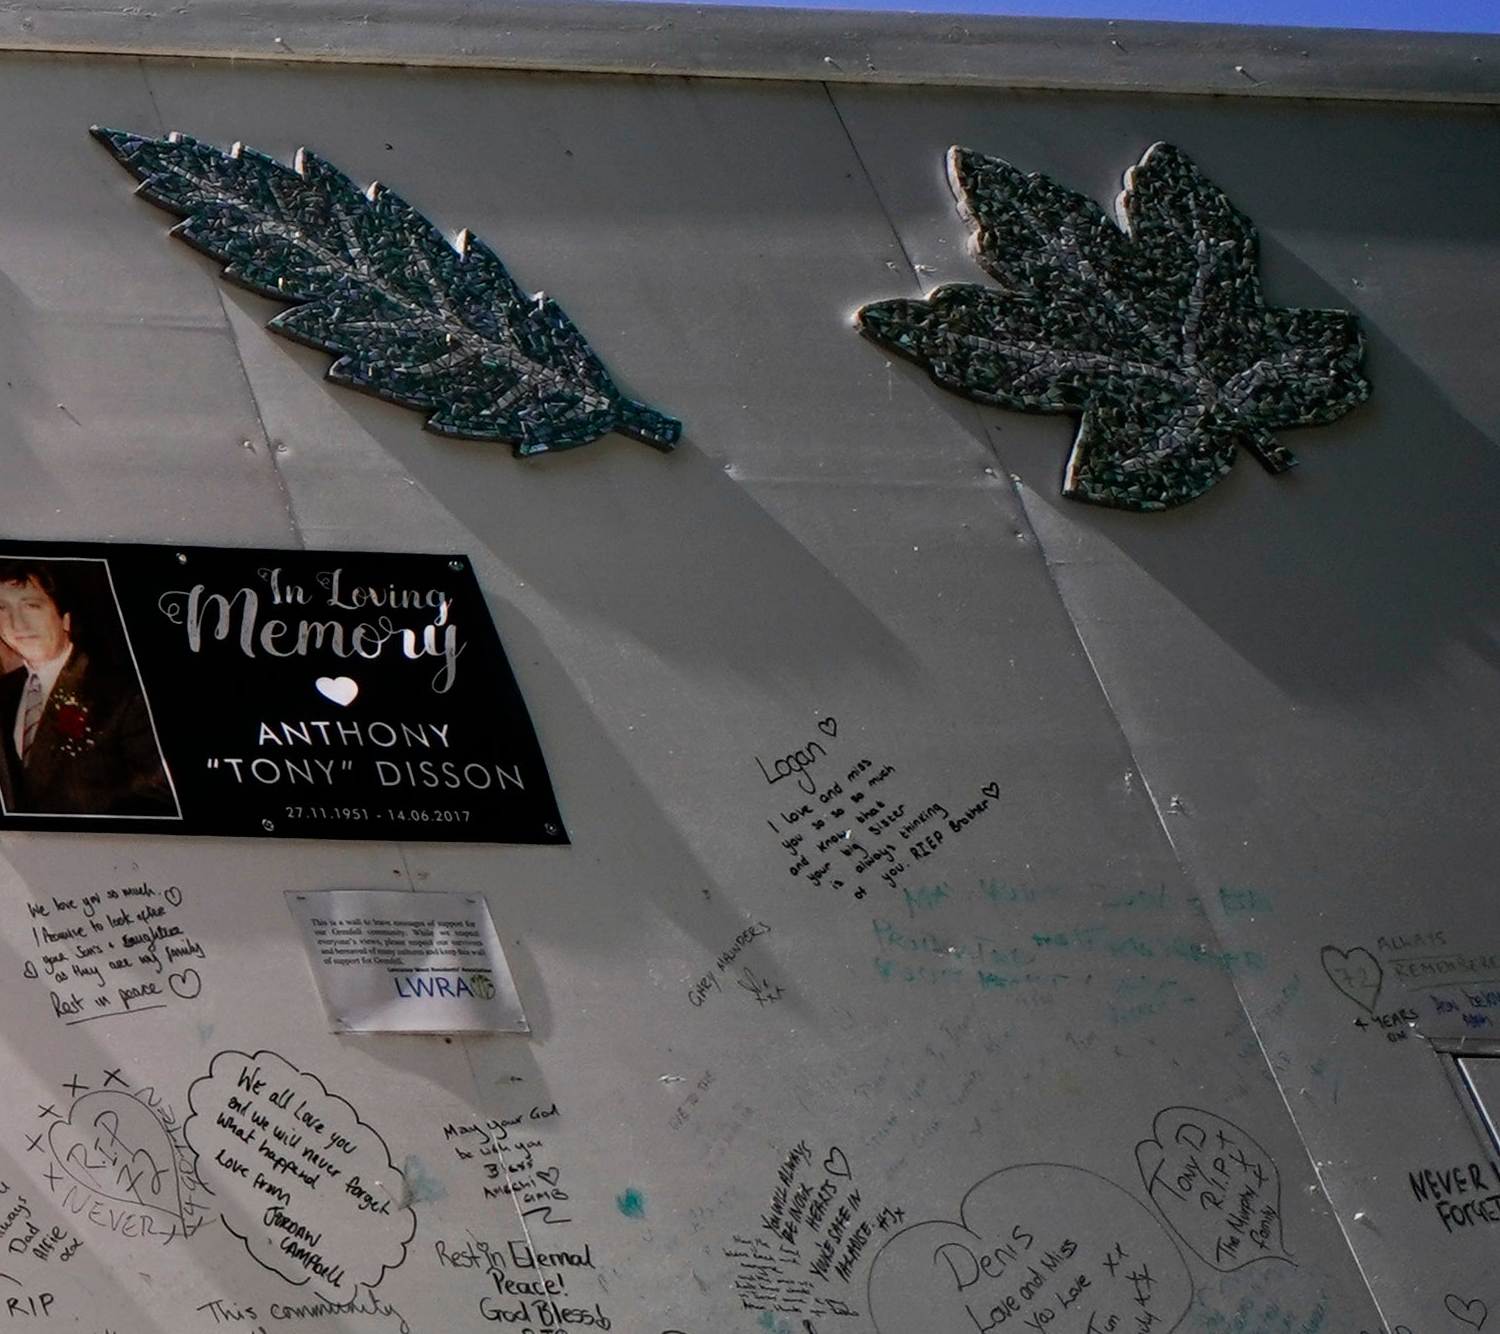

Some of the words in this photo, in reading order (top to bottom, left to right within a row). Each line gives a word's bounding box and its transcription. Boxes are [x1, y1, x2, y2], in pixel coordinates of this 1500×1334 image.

[258, 568, 312, 604] In
[316, 569, 452, 626] Loving
[158, 585, 467, 693] Memory
[259, 722, 448, 747] ANTHONY
[207, 758, 352, 784] "TONY"
[377, 761, 524, 790] DISSON
[755, 741, 826, 795] Logan
[286, 807, 368, 820] 27.11.1951
[388, 809, 469, 822] 14.06.2017
[395, 977, 473, 998] LWRA
